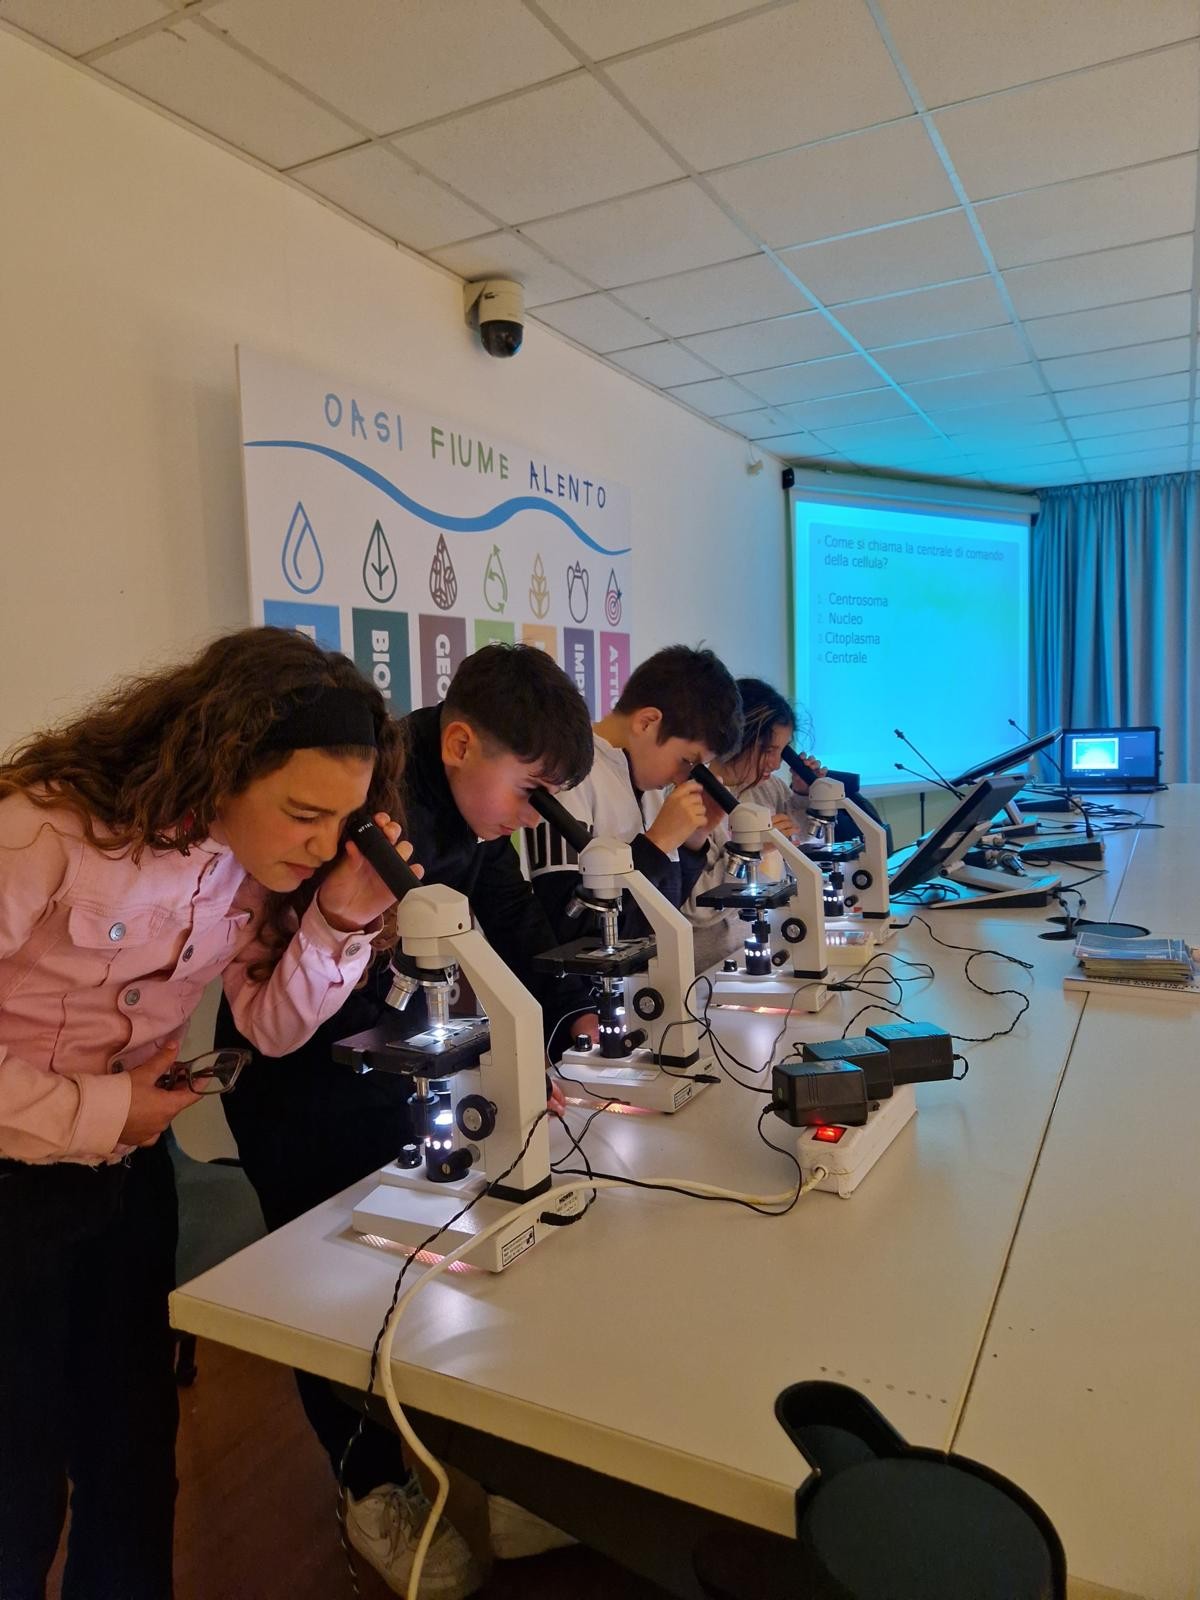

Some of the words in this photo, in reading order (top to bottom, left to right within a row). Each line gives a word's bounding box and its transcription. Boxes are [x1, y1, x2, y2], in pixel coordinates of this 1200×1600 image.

[324, 393, 403, 451] OASI
[430, 426, 509, 481] FIUME
[529, 461, 606, 509] ALENTO
[824, 535, 854, 550] Come
[857, 538, 865, 550] si
[868, 538, 903, 554] chiama
[905, 541, 914, 555] la
[917, 543, 953, 558] centrale
[955, 545, 964, 559] di
[965, 548, 1005, 561] comando
[824, 553, 849, 567] della
[852, 555, 888, 569] cellula?
[828, 592, 888, 608] Centrosoma
[828, 612, 863, 625] Nucleo
[824, 631, 880, 647] Citoplasma
[824, 650, 868, 664] Centrale
[435, 633, 452, 703] GEO
